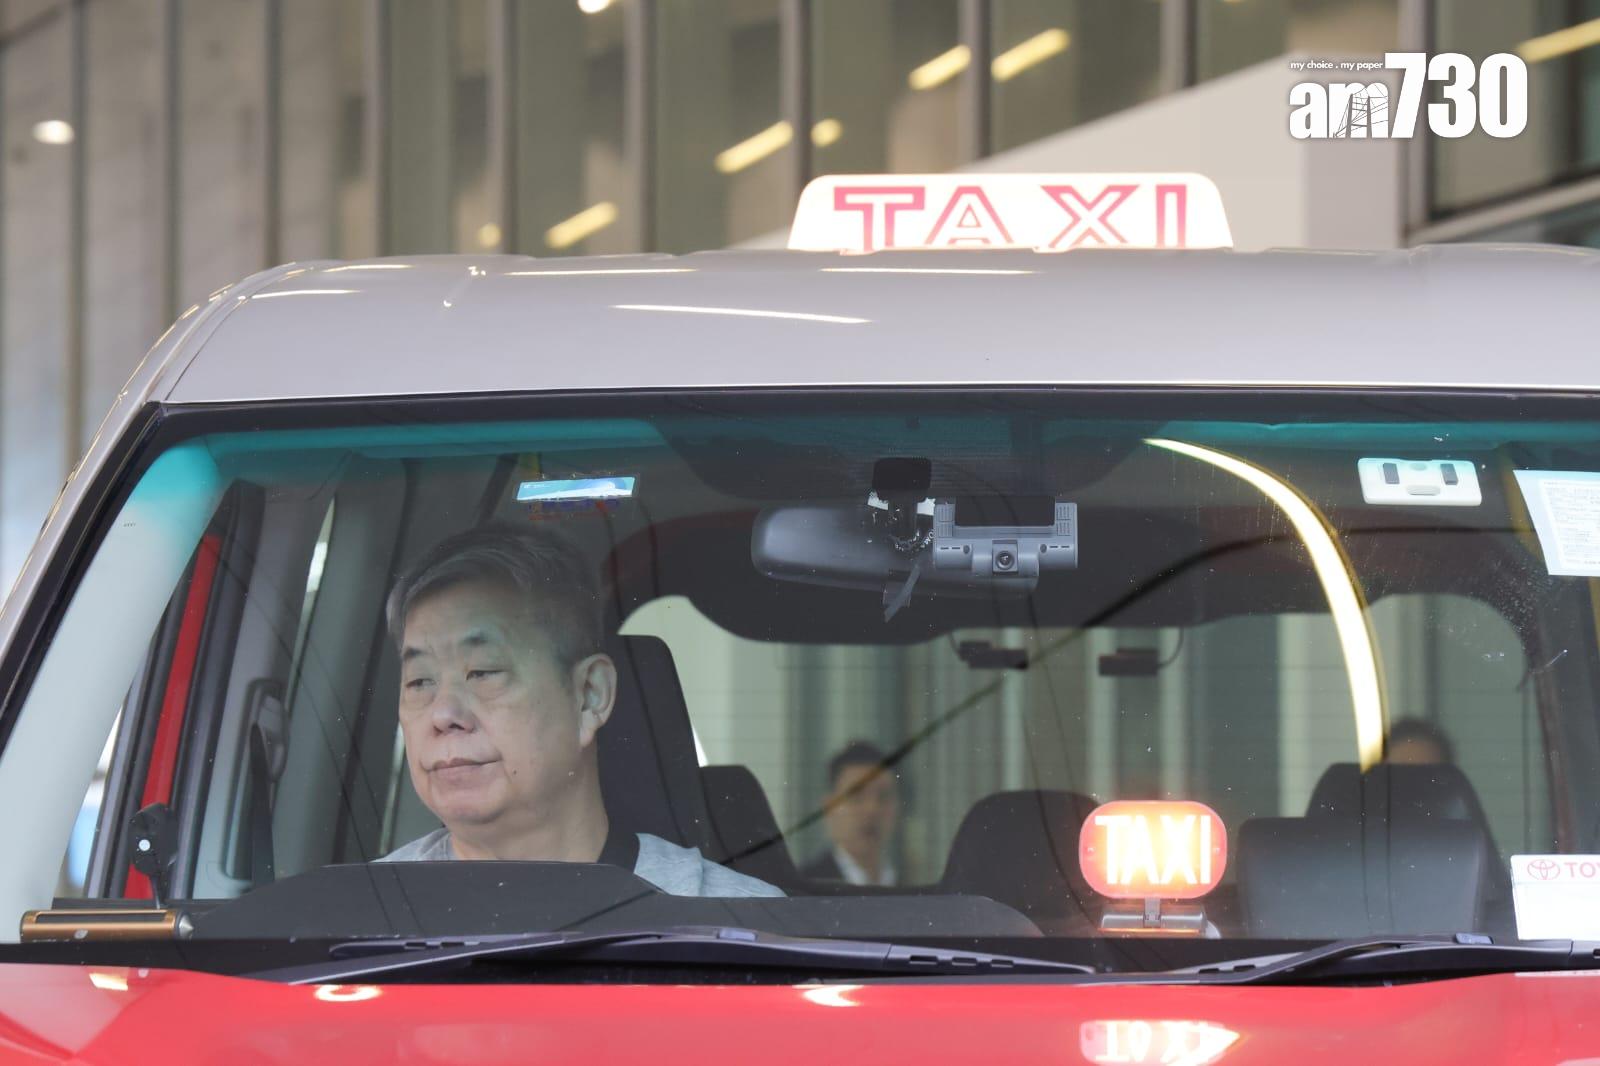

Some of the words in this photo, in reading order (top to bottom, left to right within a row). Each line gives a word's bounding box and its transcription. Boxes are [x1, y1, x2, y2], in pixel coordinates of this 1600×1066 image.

[833, 184, 1187, 251] TAXI
[1094, 815, 1212, 885] TAXI
[1563, 861, 1600, 879] TO
